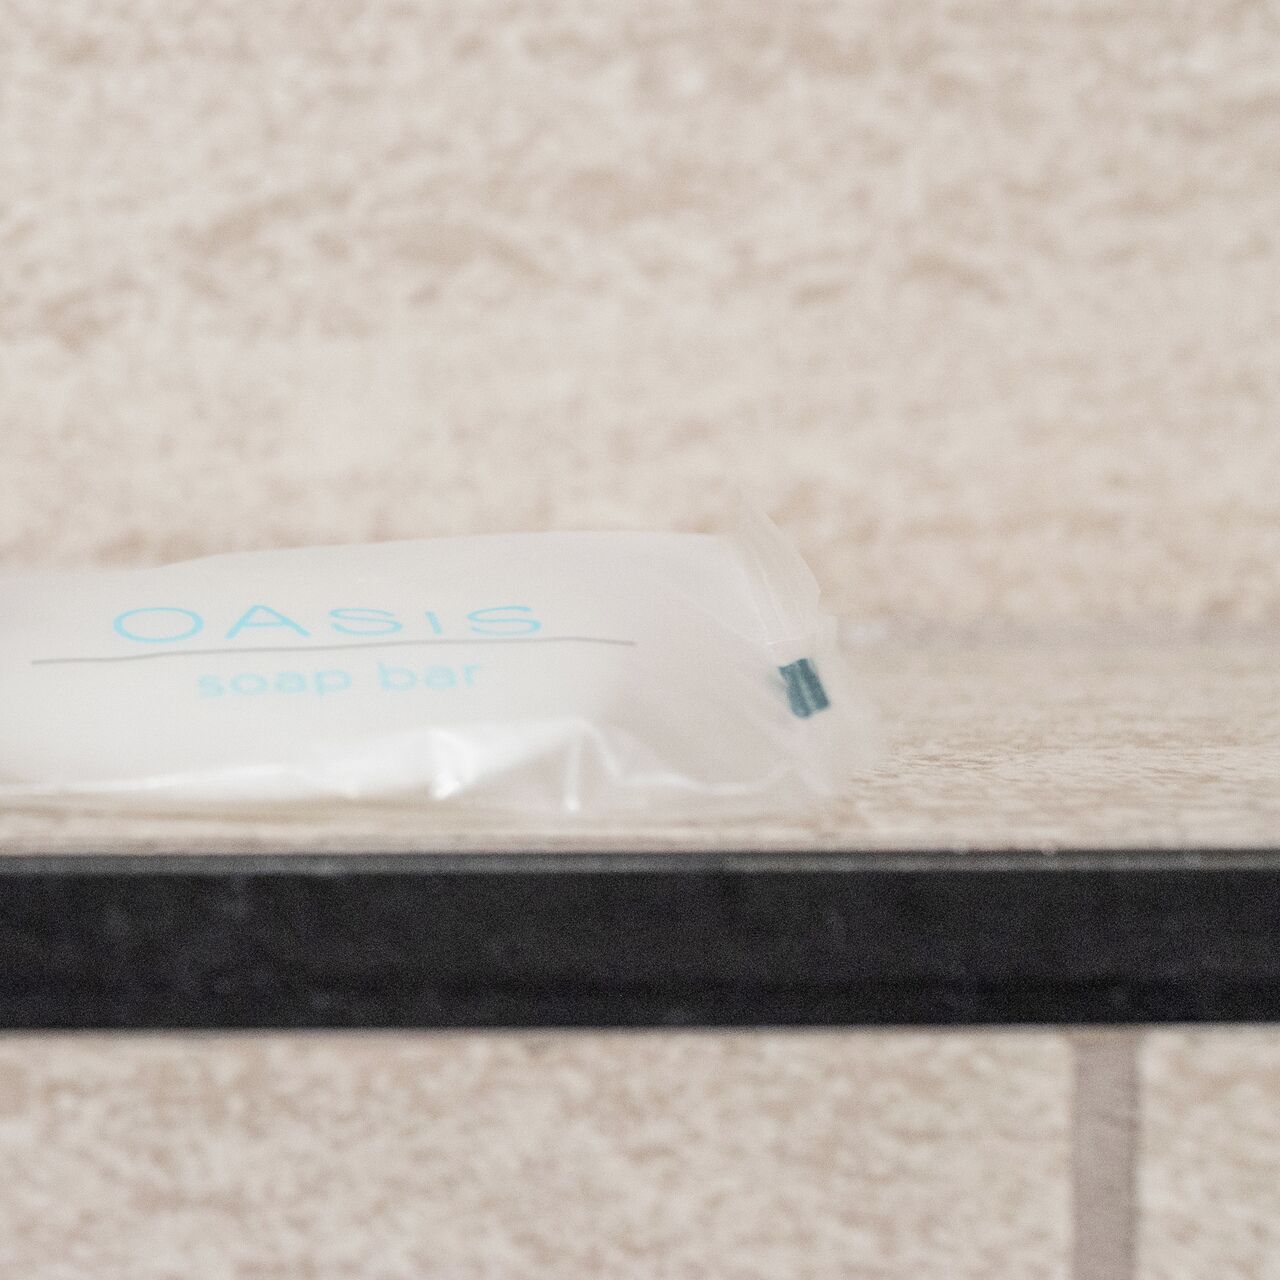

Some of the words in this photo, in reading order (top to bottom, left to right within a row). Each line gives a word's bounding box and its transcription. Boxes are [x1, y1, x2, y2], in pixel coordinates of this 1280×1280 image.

[113, 604, 543, 644] OASIS
[197, 666, 352, 699] soap
[377, 660, 483, 692] bar
